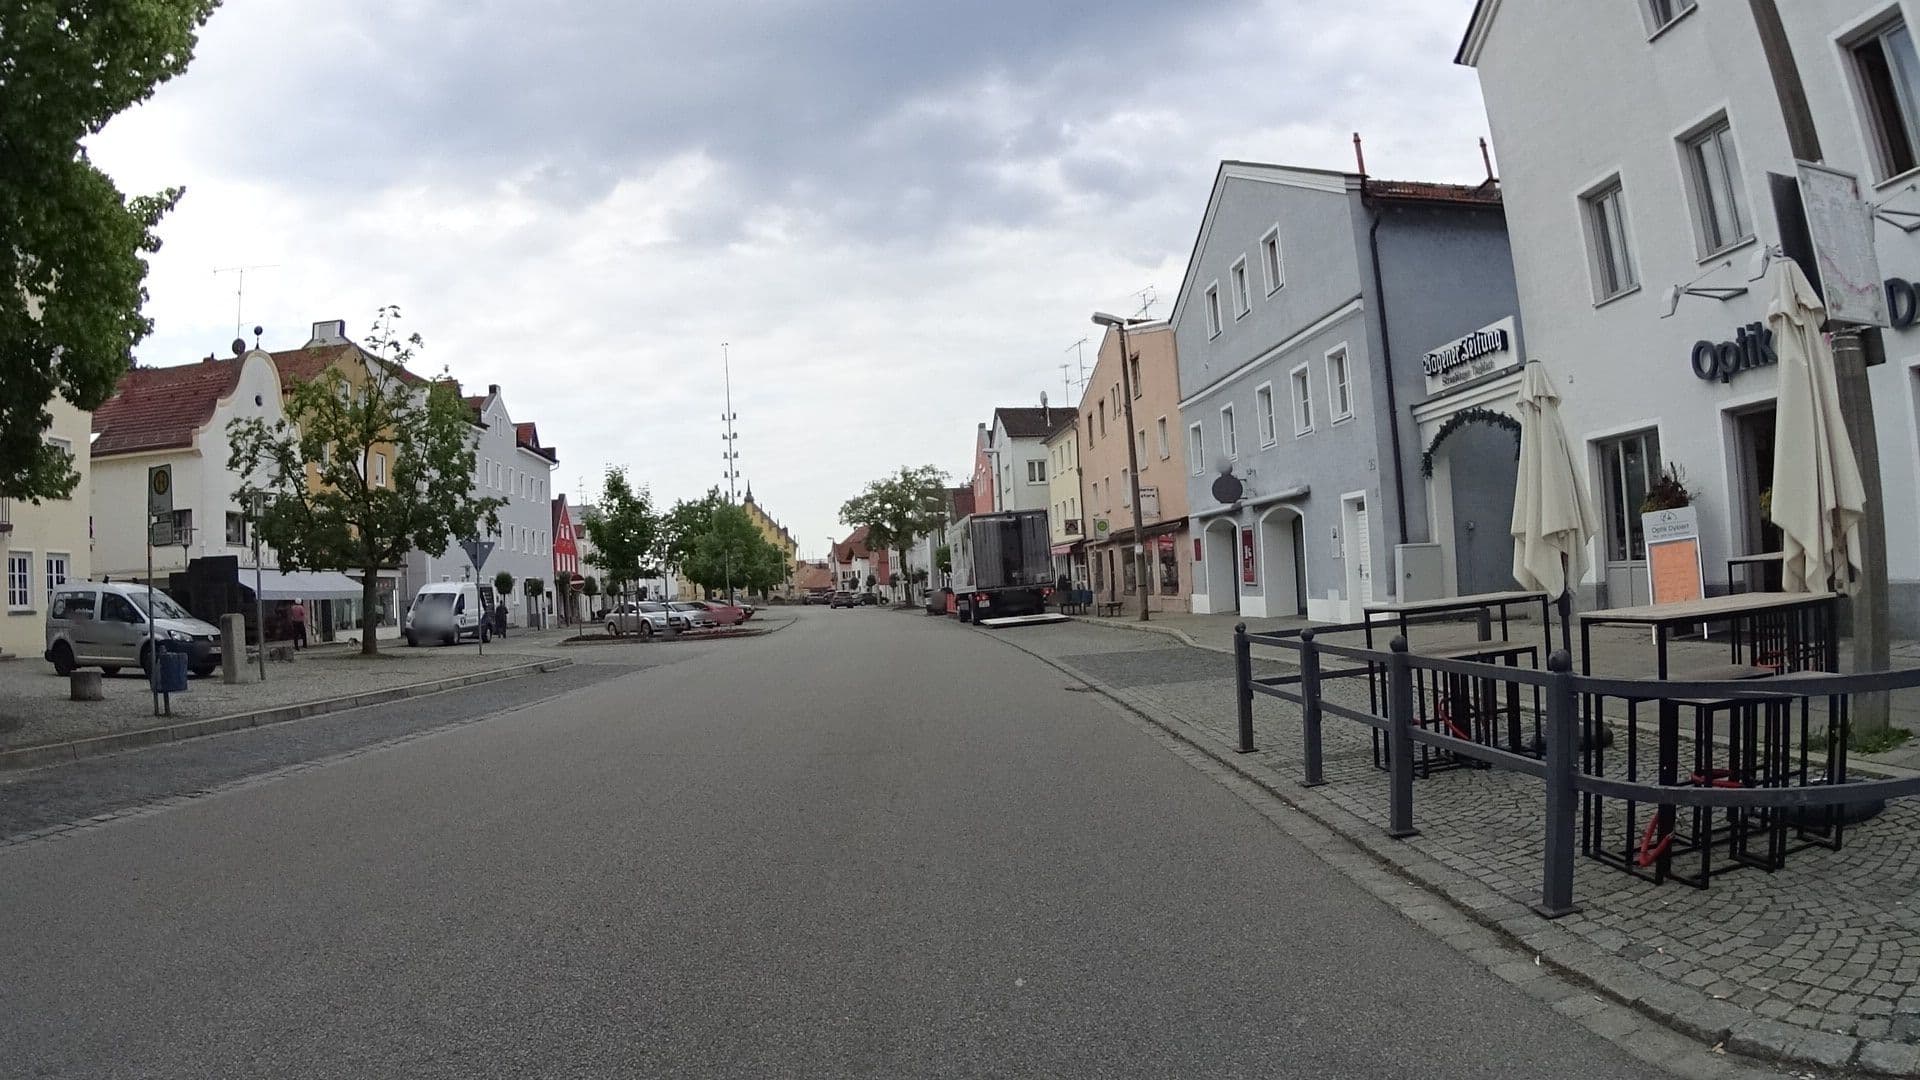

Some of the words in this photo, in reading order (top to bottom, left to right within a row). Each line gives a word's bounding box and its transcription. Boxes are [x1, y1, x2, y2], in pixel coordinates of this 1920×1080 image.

[1423, 344, 1460, 375] Bogener
[1461, 329, 1504, 361] Zeitung
[1692, 321, 1778, 383] Optik
[1884, 278, 1920, 331] D
